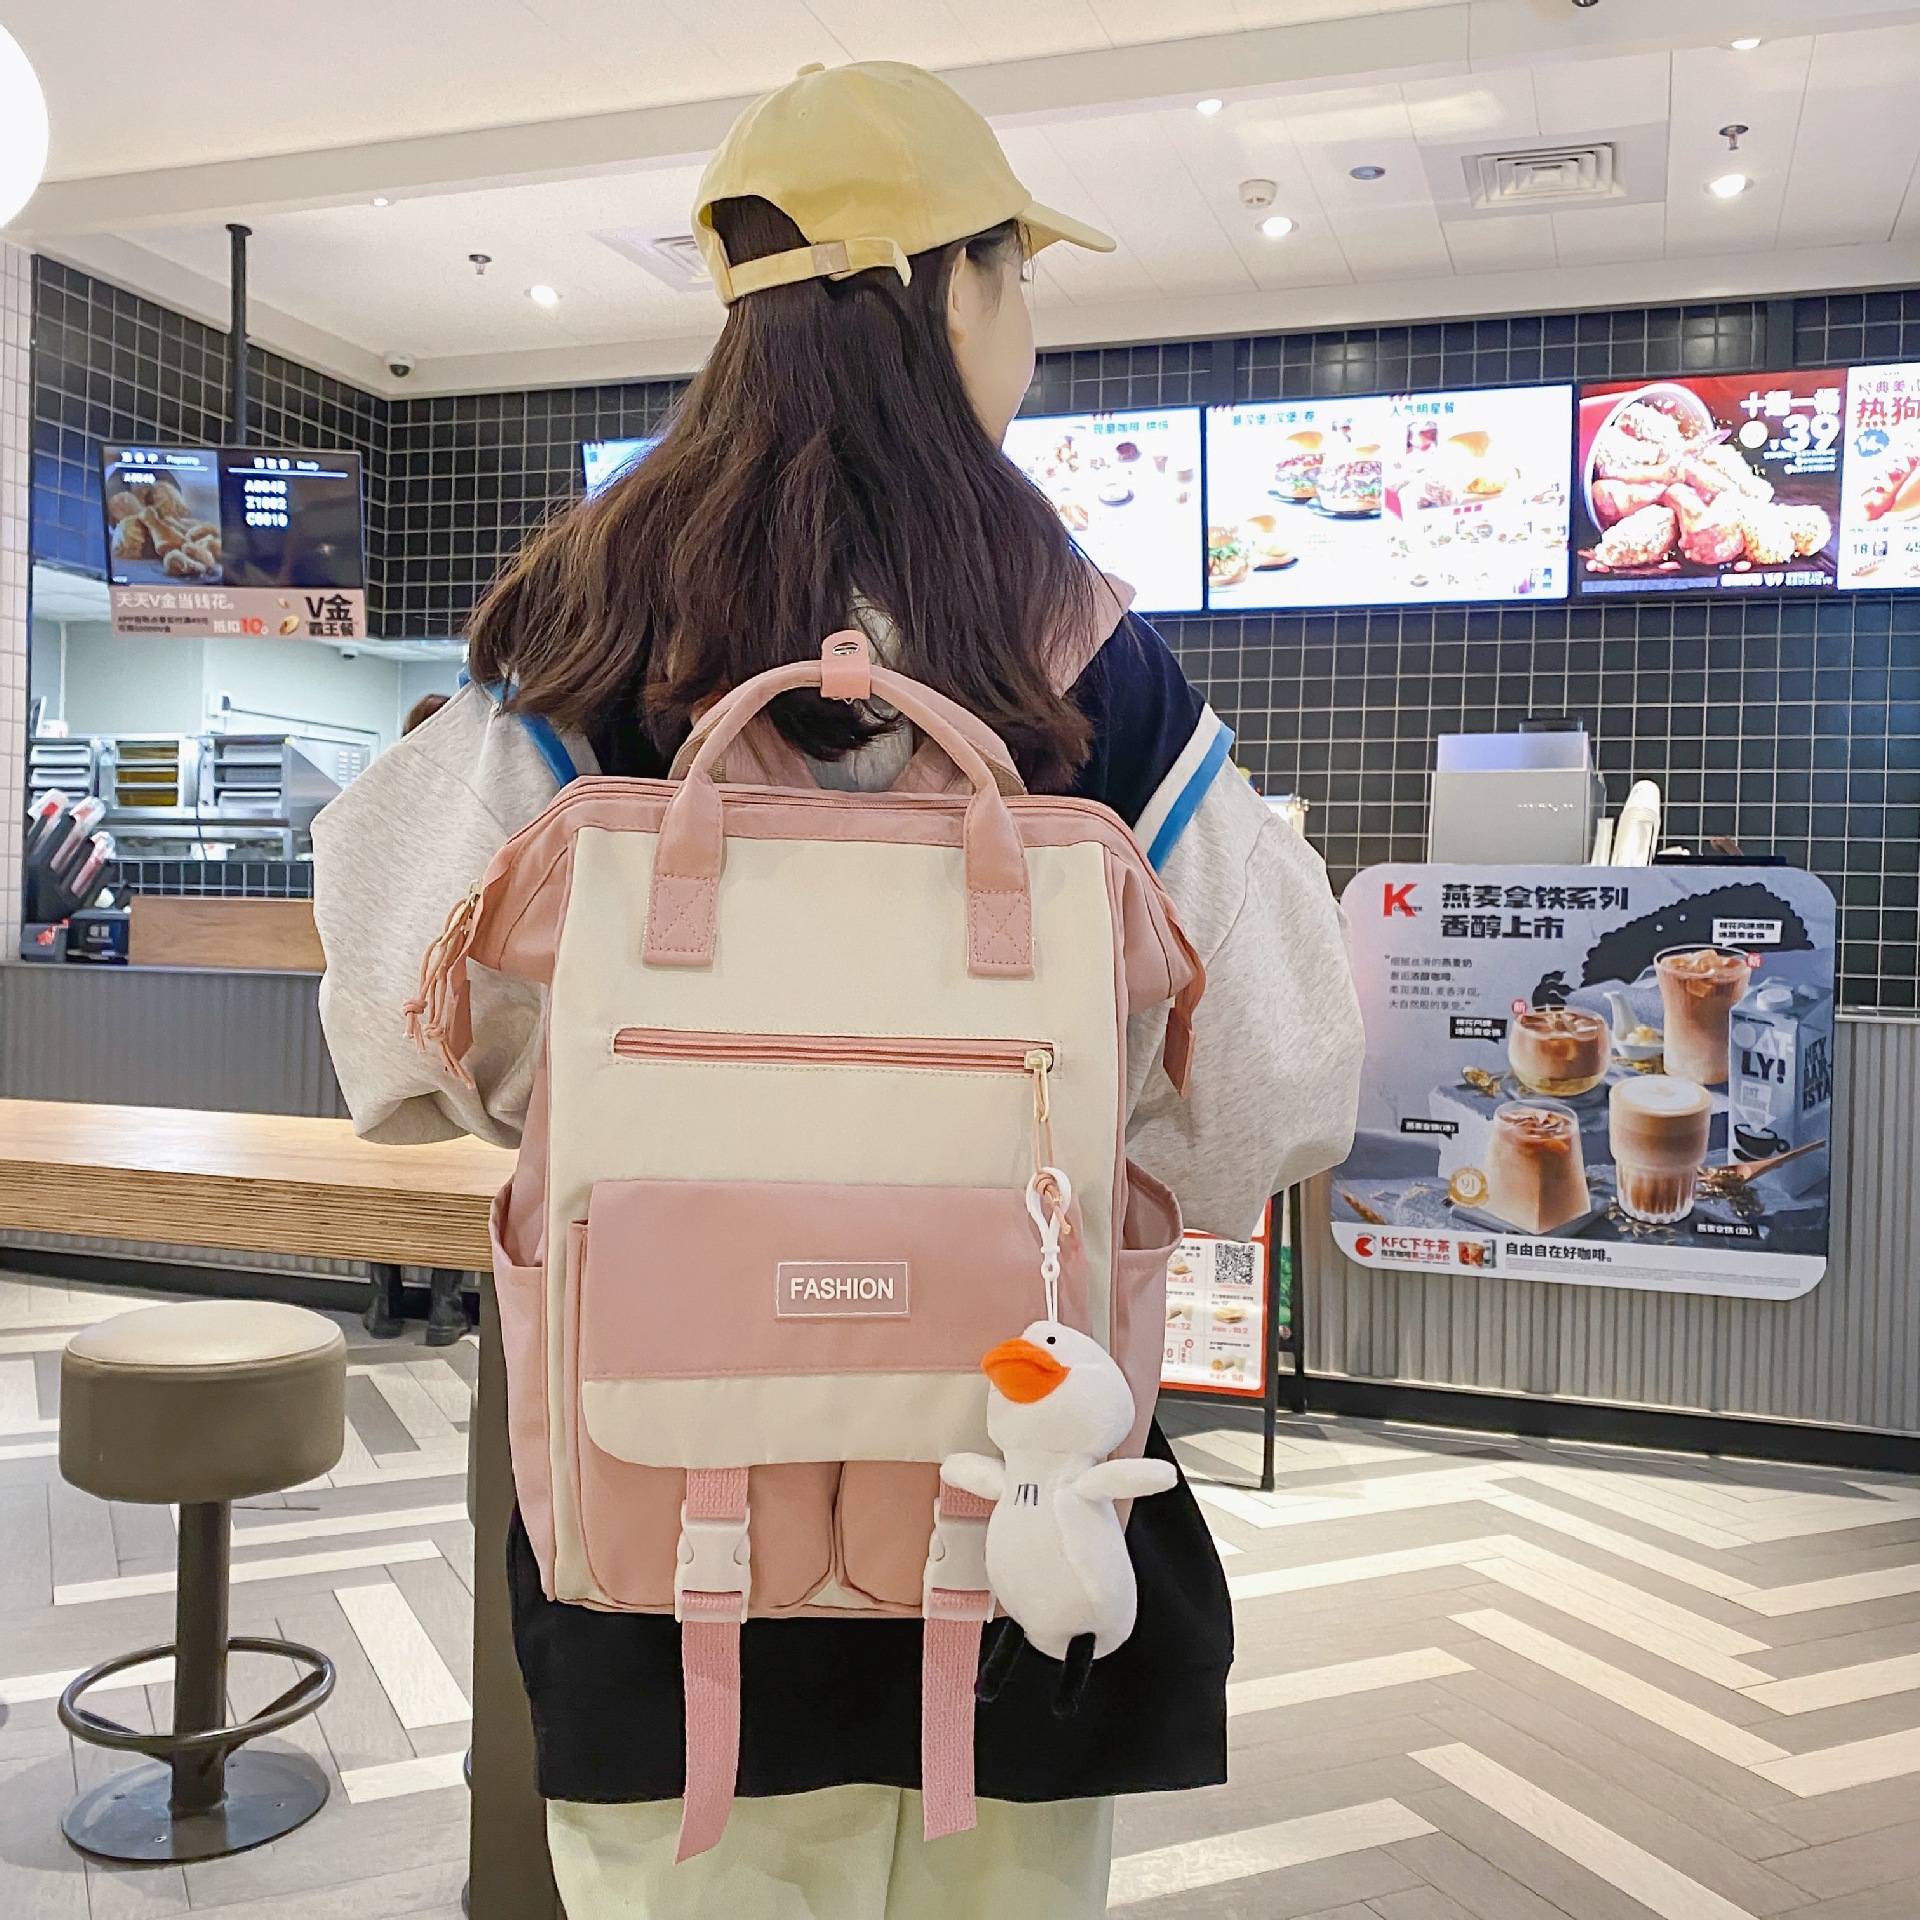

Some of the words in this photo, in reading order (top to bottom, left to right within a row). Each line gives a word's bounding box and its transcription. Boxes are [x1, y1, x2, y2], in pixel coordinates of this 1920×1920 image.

[304, 593, 354, 621] V金
[1441, 883, 1630, 911] 燕麦拿铁系列
[1440, 914, 1565, 940] 香醇上市
[1741, 1050, 1787, 1084] LY!
[1381, 1236, 1450, 1253] KFC下午茶
[1506, 1242, 1612, 1263] 自由自在好咖啡。
[790, 1277, 894, 1301] FASHION
